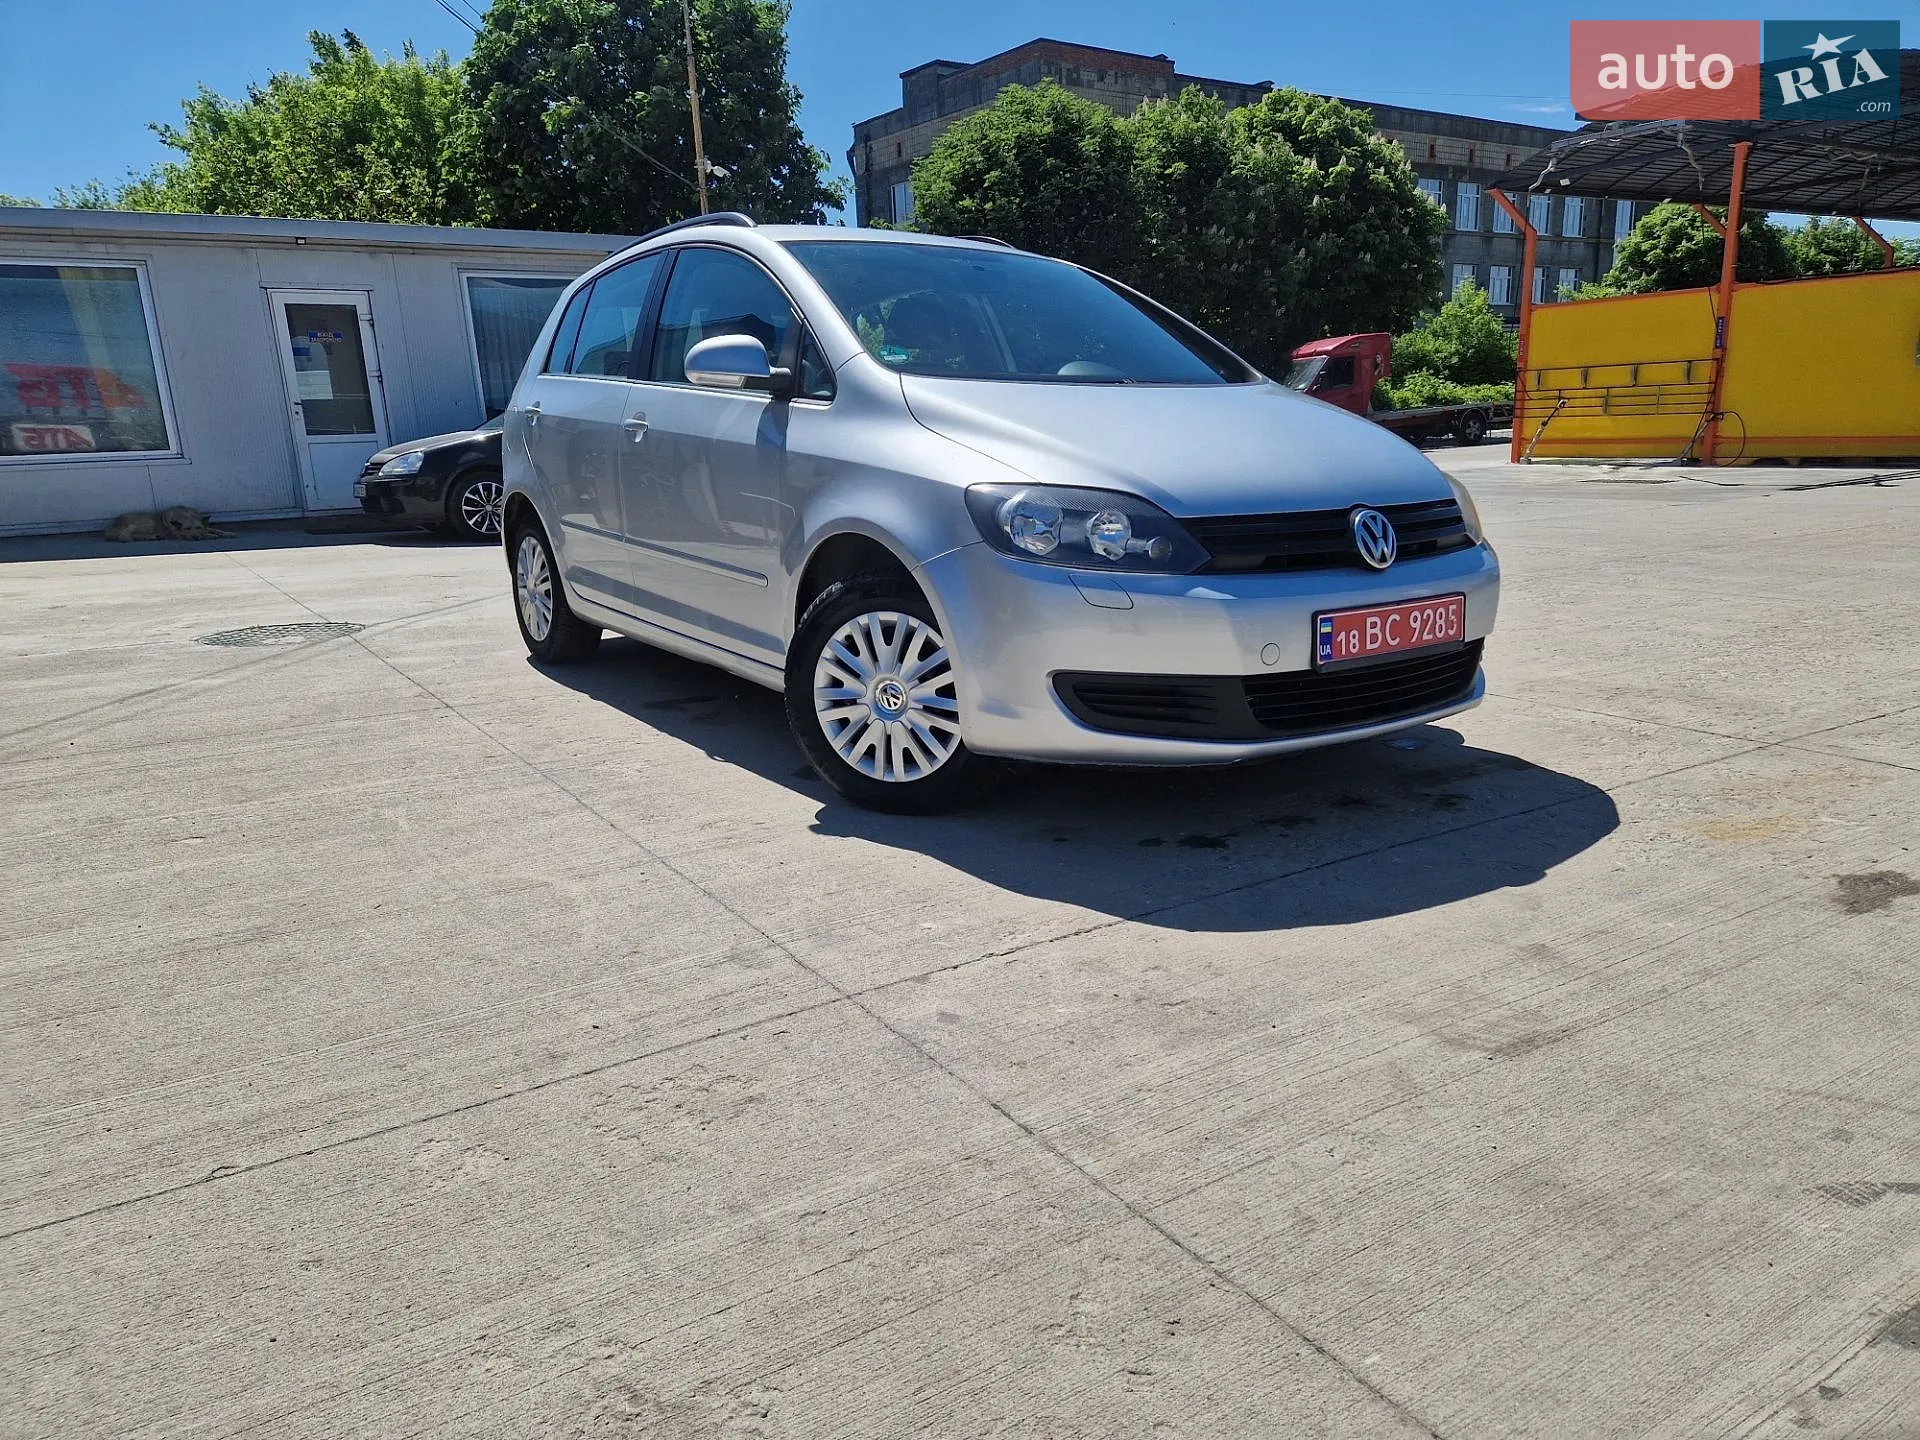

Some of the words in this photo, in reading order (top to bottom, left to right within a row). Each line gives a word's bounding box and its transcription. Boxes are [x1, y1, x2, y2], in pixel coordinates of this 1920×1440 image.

[1337, 630, 1359, 655] 18
[1366, 615, 1400, 650] BC
[1410, 605, 1457, 642] 9285
[1320, 645, 1332, 655] UA
